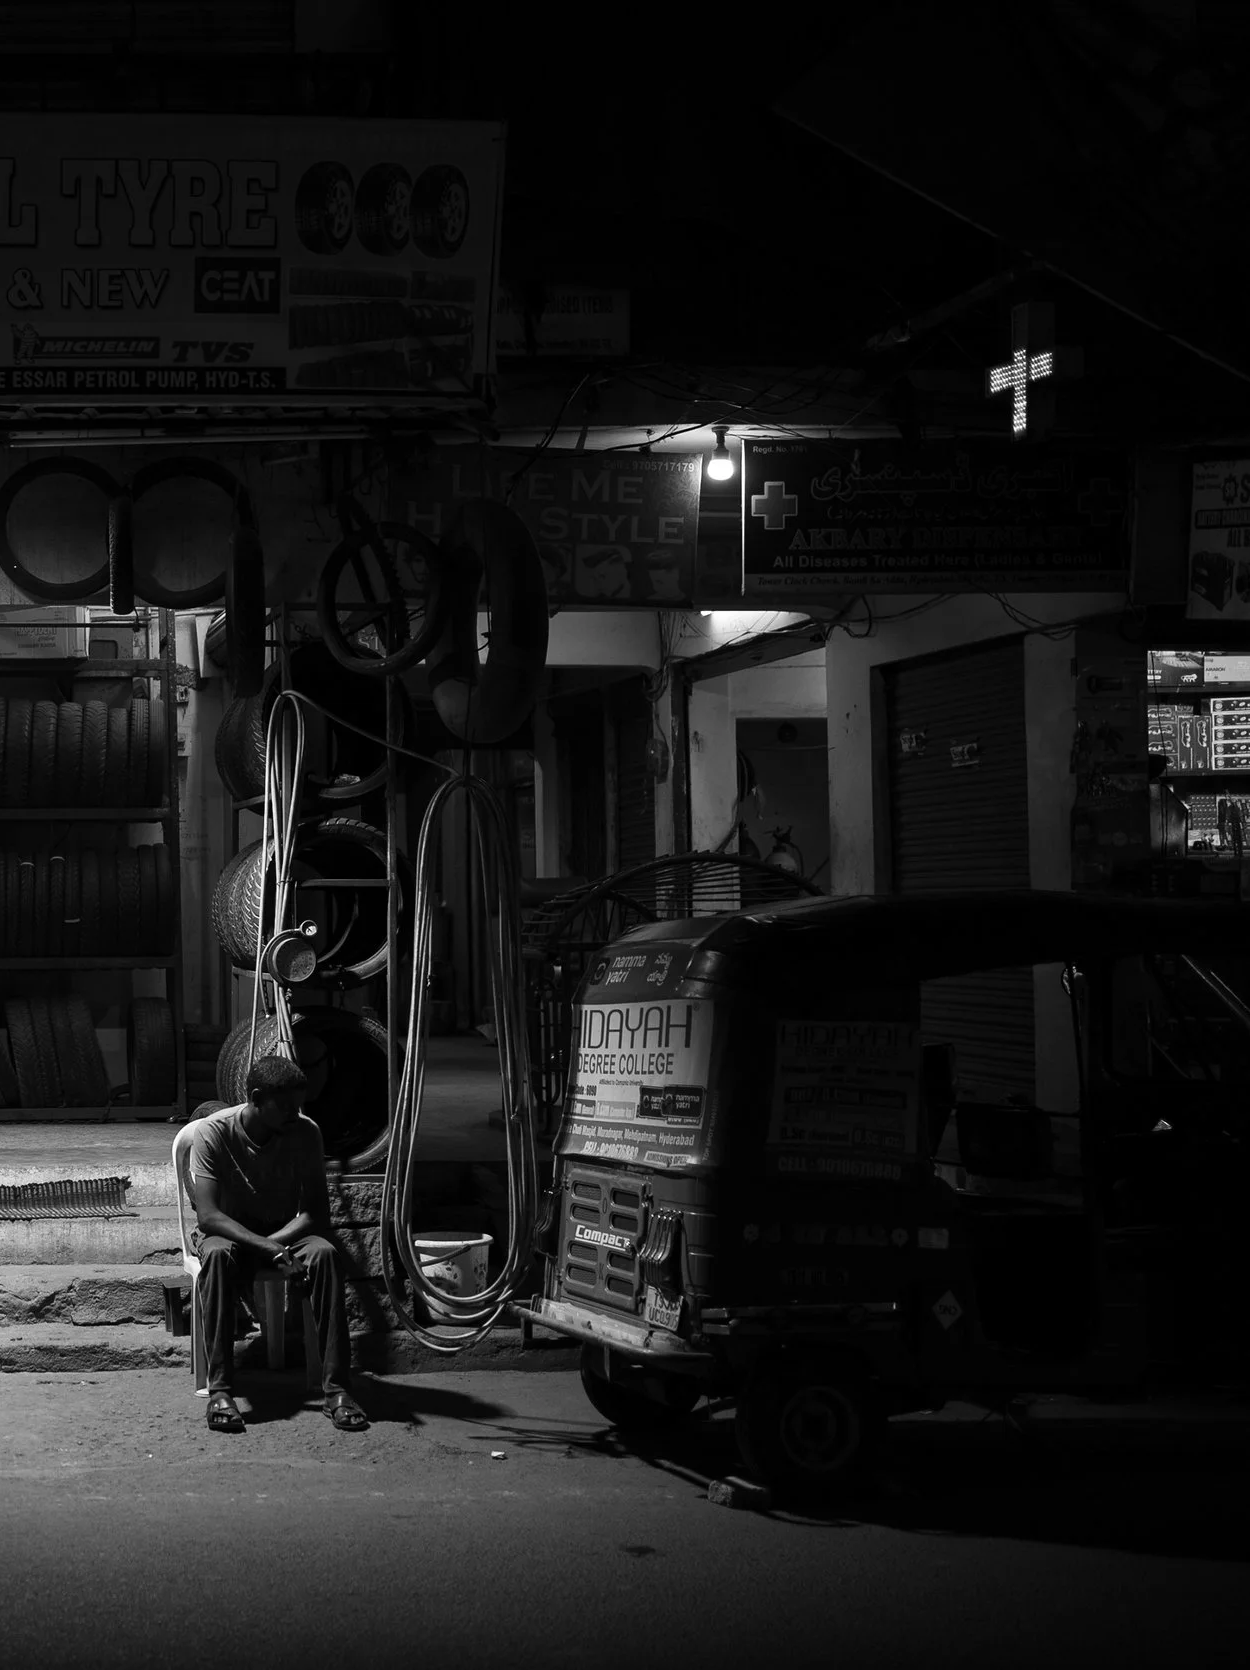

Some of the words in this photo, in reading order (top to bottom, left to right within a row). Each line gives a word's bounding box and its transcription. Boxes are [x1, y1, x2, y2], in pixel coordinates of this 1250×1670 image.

[60, 158, 278, 249] TYRE
[6, 267, 43, 310] &
[60, 268, 170, 309] NEW
[199, 269, 277, 303] CEAT
[42, 340, 156, 354] MICHELIN
[172, 340, 255, 363] TVS
[12, 370, 68, 389] ESSAR
[73, 370, 140, 389] PETROL
[145, 371, 199, 391] PUMP,
[752, 445, 774, 455] Regd.
[571, 468, 644, 504] ME
[538, 505, 685, 545] STYLE
[788, 527, 908, 550] AKBARY
[773, 555, 793, 568] All
[798, 555, 868, 569] Diseases
[872, 554, 930, 568] Treated
[612, 955, 647, 968] namma
[605, 968, 631, 986] yatri
[574, 1004, 693, 1049] HIDAYAH
[781, 1024, 913, 1049] HIDAYAH
[578, 1053, 616, 1074] DEGREE
[619, 1053, 675, 1075] COLLEGE
[676, 1093, 700, 1103] namma
[676, 1101, 691, 1109] yatri
[659, 1132, 695, 1146] Hyderabad
[575, 1224, 631, 1247] Compact
